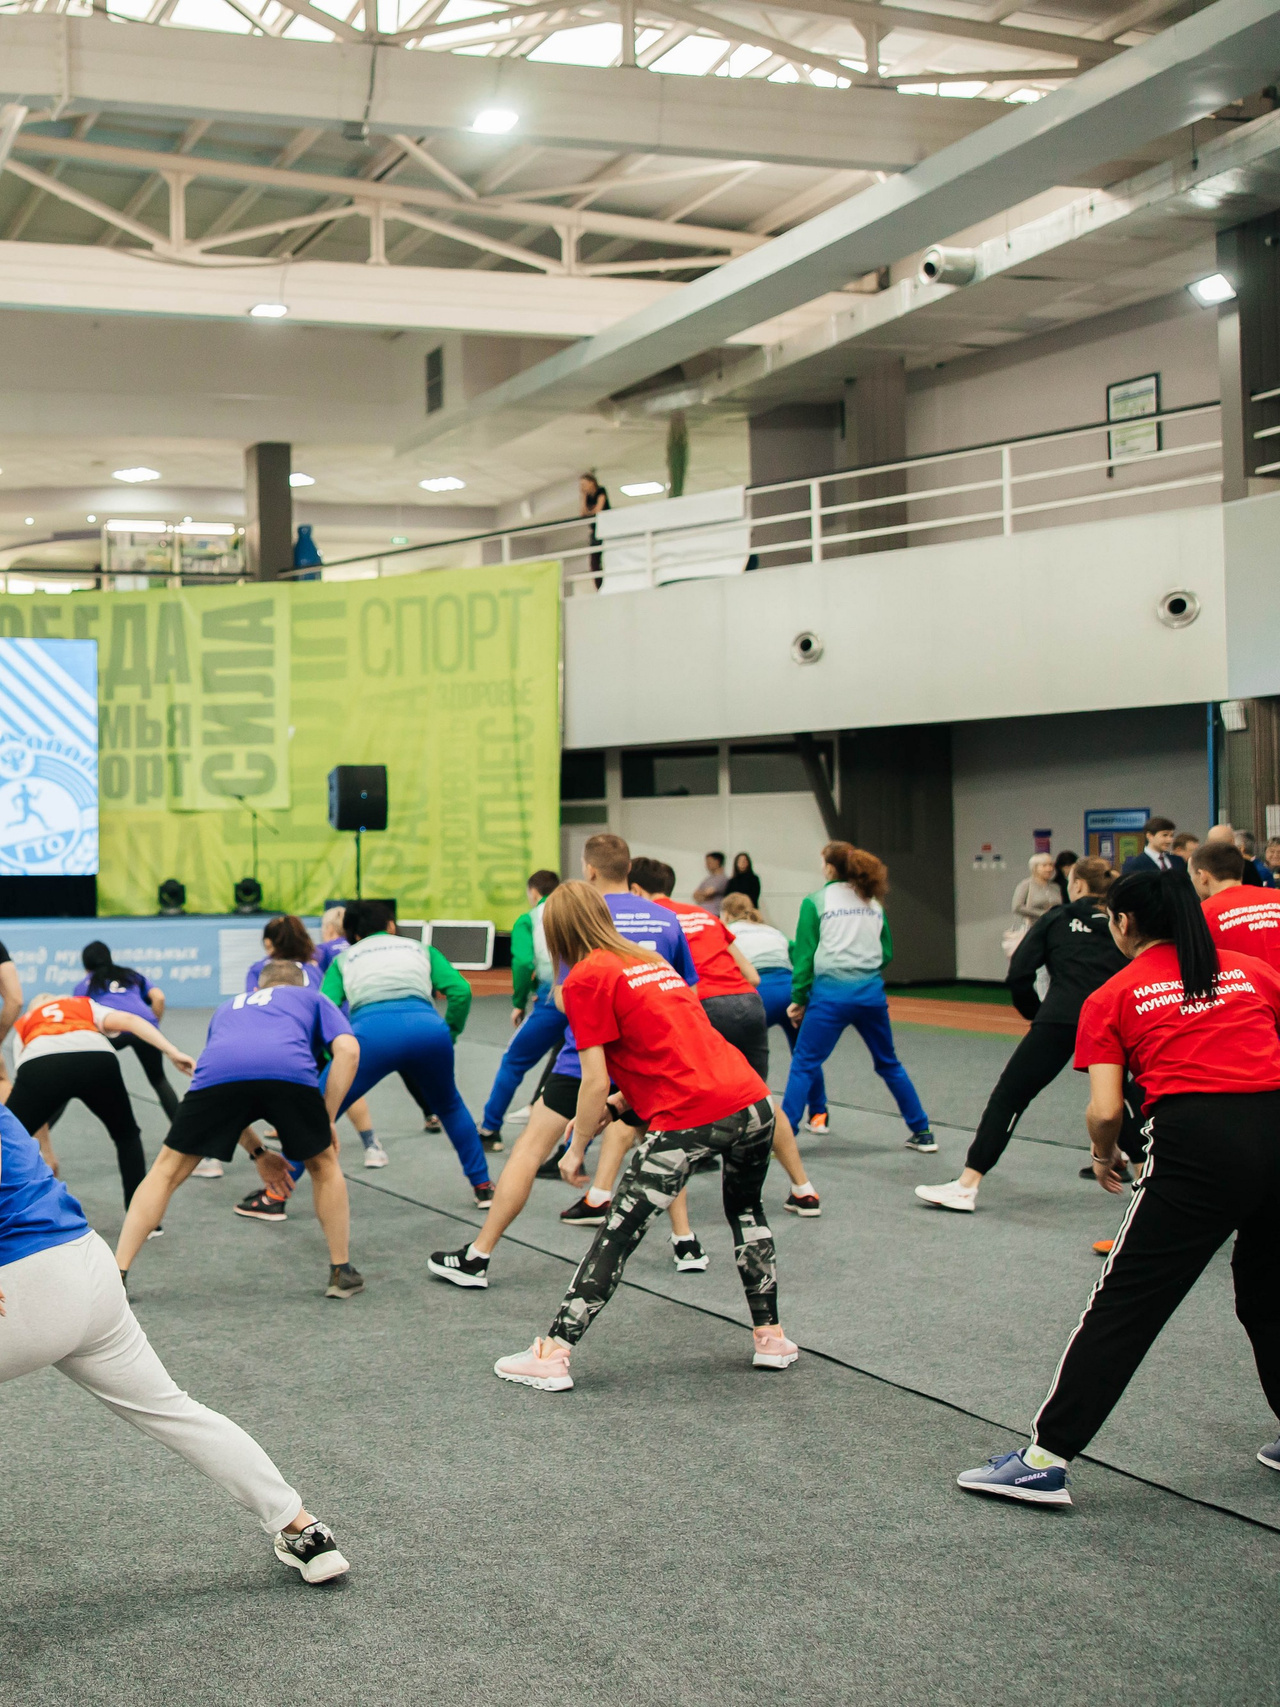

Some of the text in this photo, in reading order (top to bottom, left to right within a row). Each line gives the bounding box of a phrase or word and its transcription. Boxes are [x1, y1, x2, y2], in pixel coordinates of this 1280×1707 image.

[358, 587, 535, 676] СПОРТ
[201, 599, 277, 797] СИЛА
[476, 715, 535, 907] ФИТНЕС
[15, 834, 67, 863] ГТО
[1218, 902, 1280, 922] НАДЕЖДИНСКИ
[1219, 911, 1280, 932] МУНИЦИПАЛЬ
[1248, 920, 1279, 932] РАЙОН
[1133, 968, 1246, 999] НАДЕЖКИЙ
[232, 987, 274, 1010] 14
[1135, 981, 1256, 1015] МУНИЦЛЬНЫЙ
[1180, 998, 1226, 1016] РАЙОН
[41, 1003, 65, 1022] 5
[1014, 1471, 1048, 1485] DEMIX
